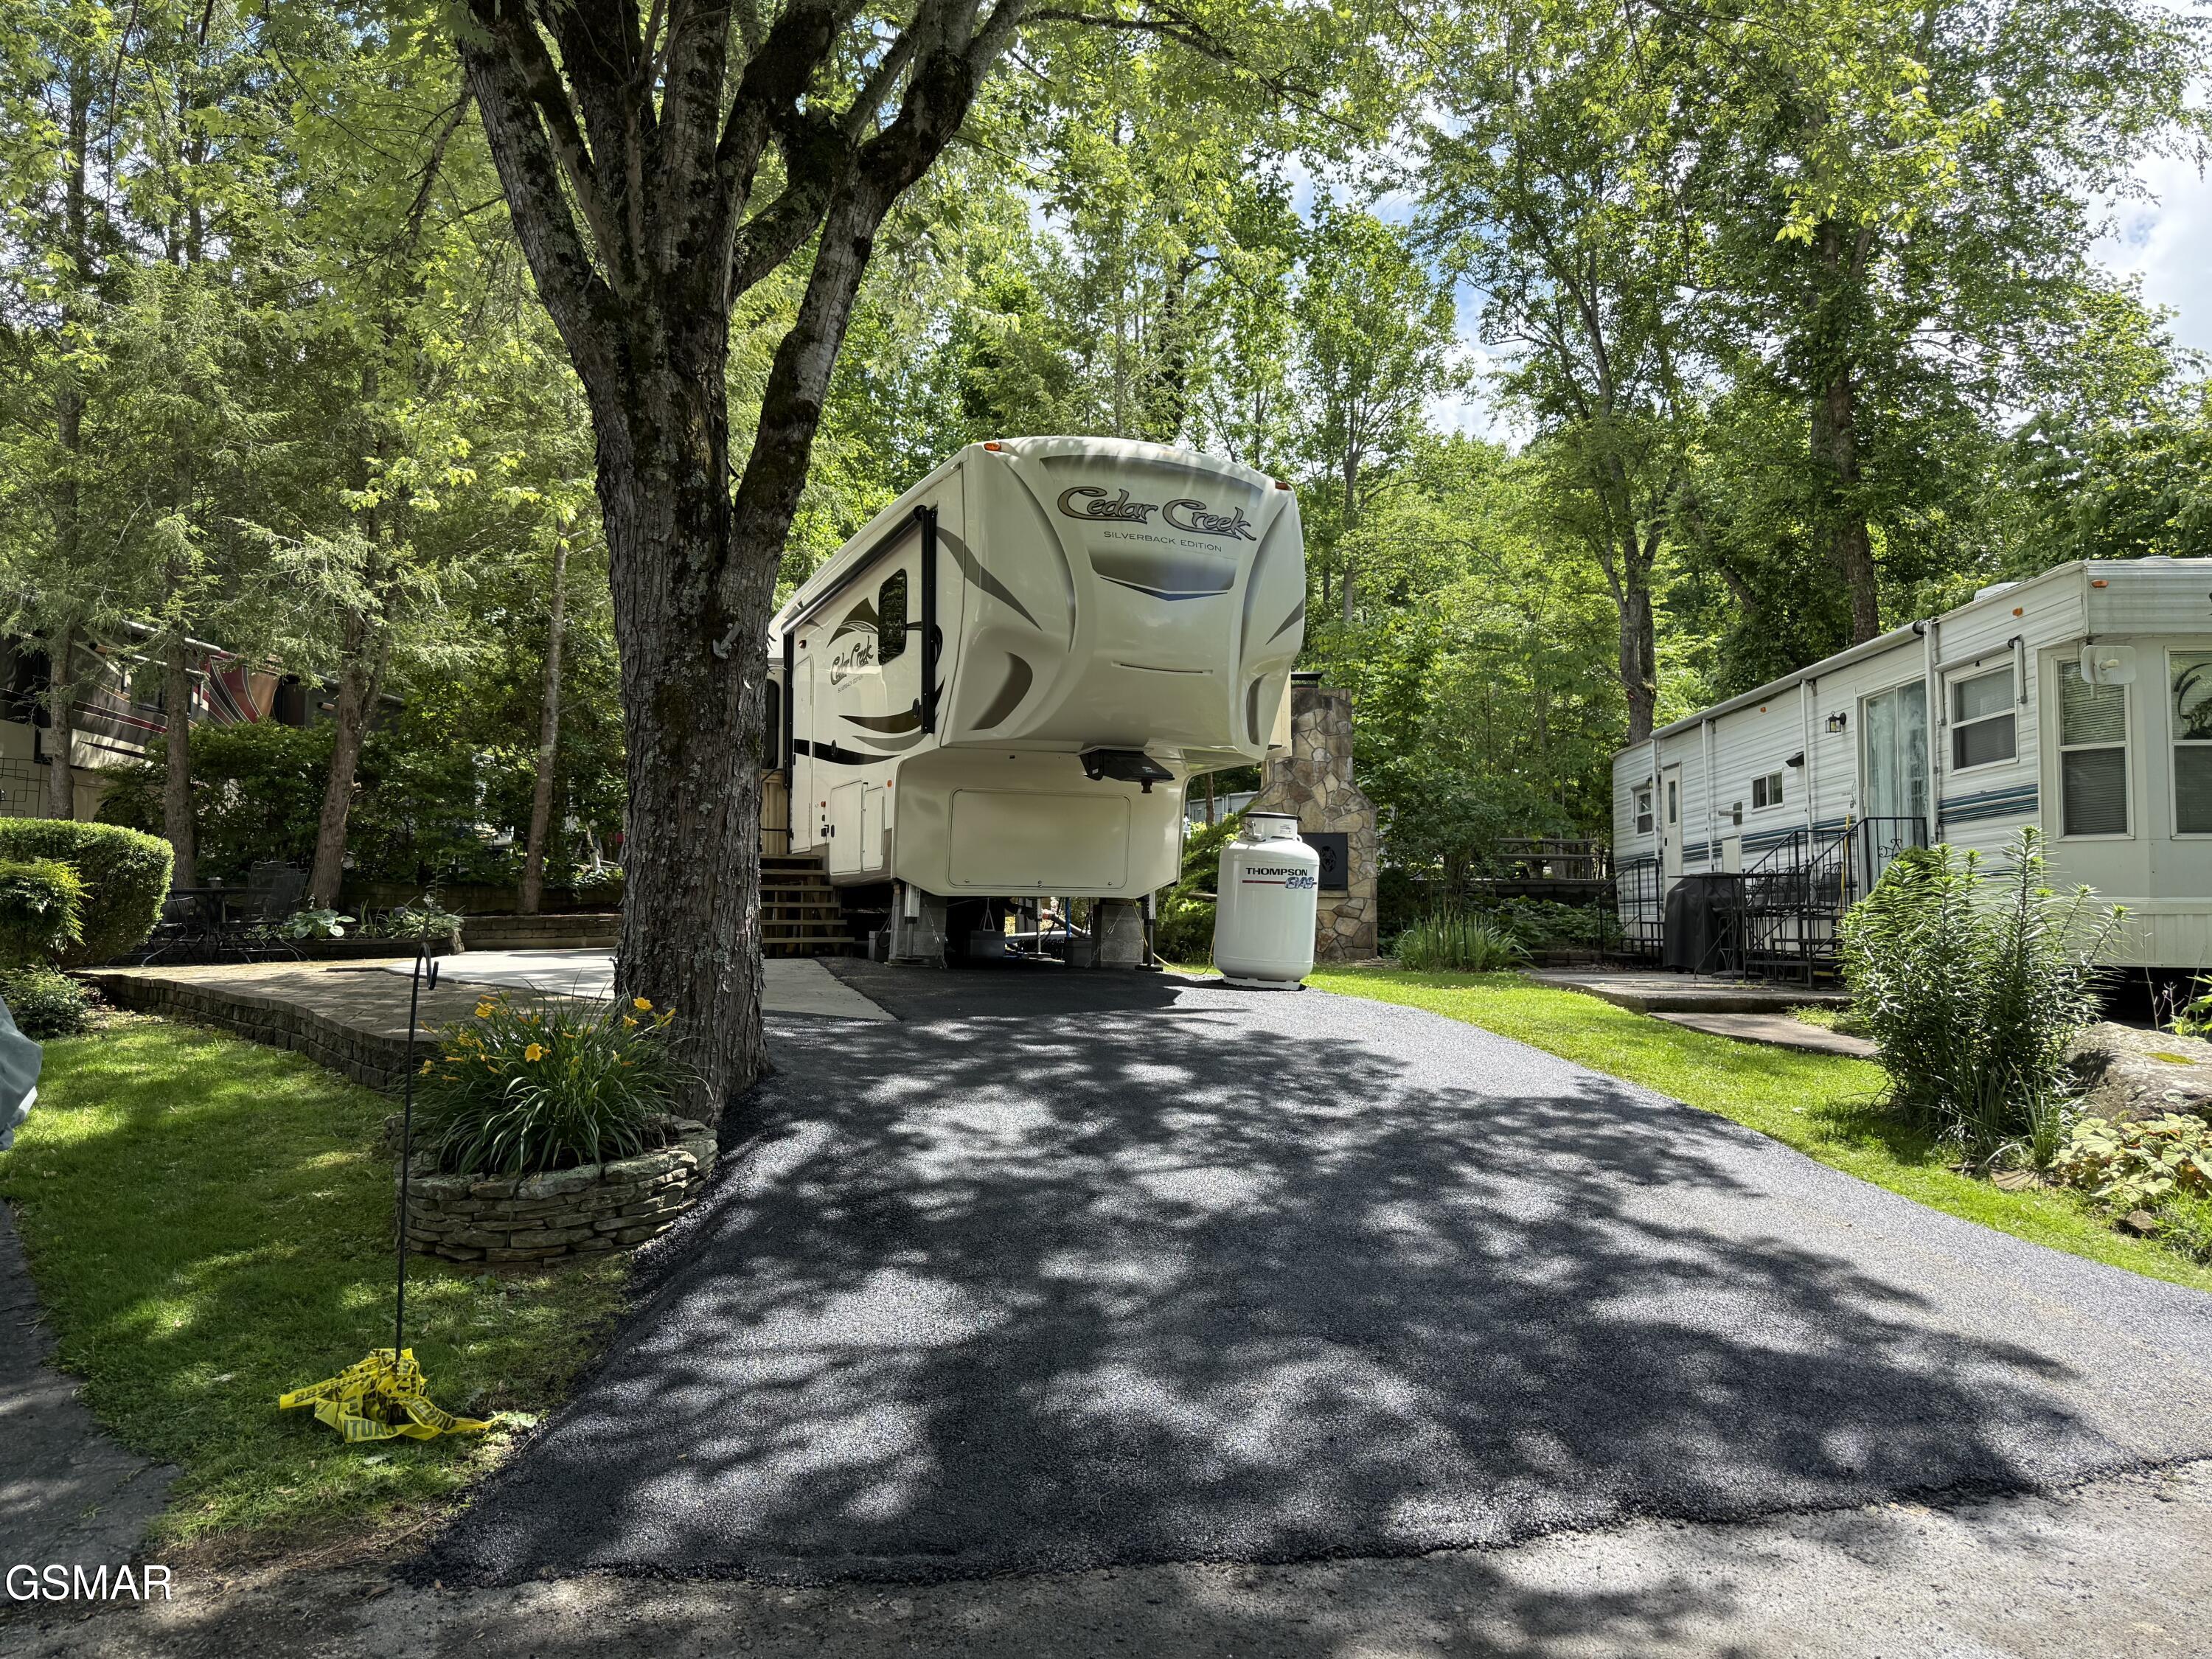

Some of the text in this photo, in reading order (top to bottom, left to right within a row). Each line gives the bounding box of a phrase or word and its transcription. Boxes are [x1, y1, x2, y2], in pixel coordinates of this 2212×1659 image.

[1057, 485, 1257, 540] Cedar Creek
[1103, 530, 1222, 552] SILVERBACK EDITION
[1245, 867, 1308, 876] THOMPSON
[1284, 876, 1315, 889] GAS
